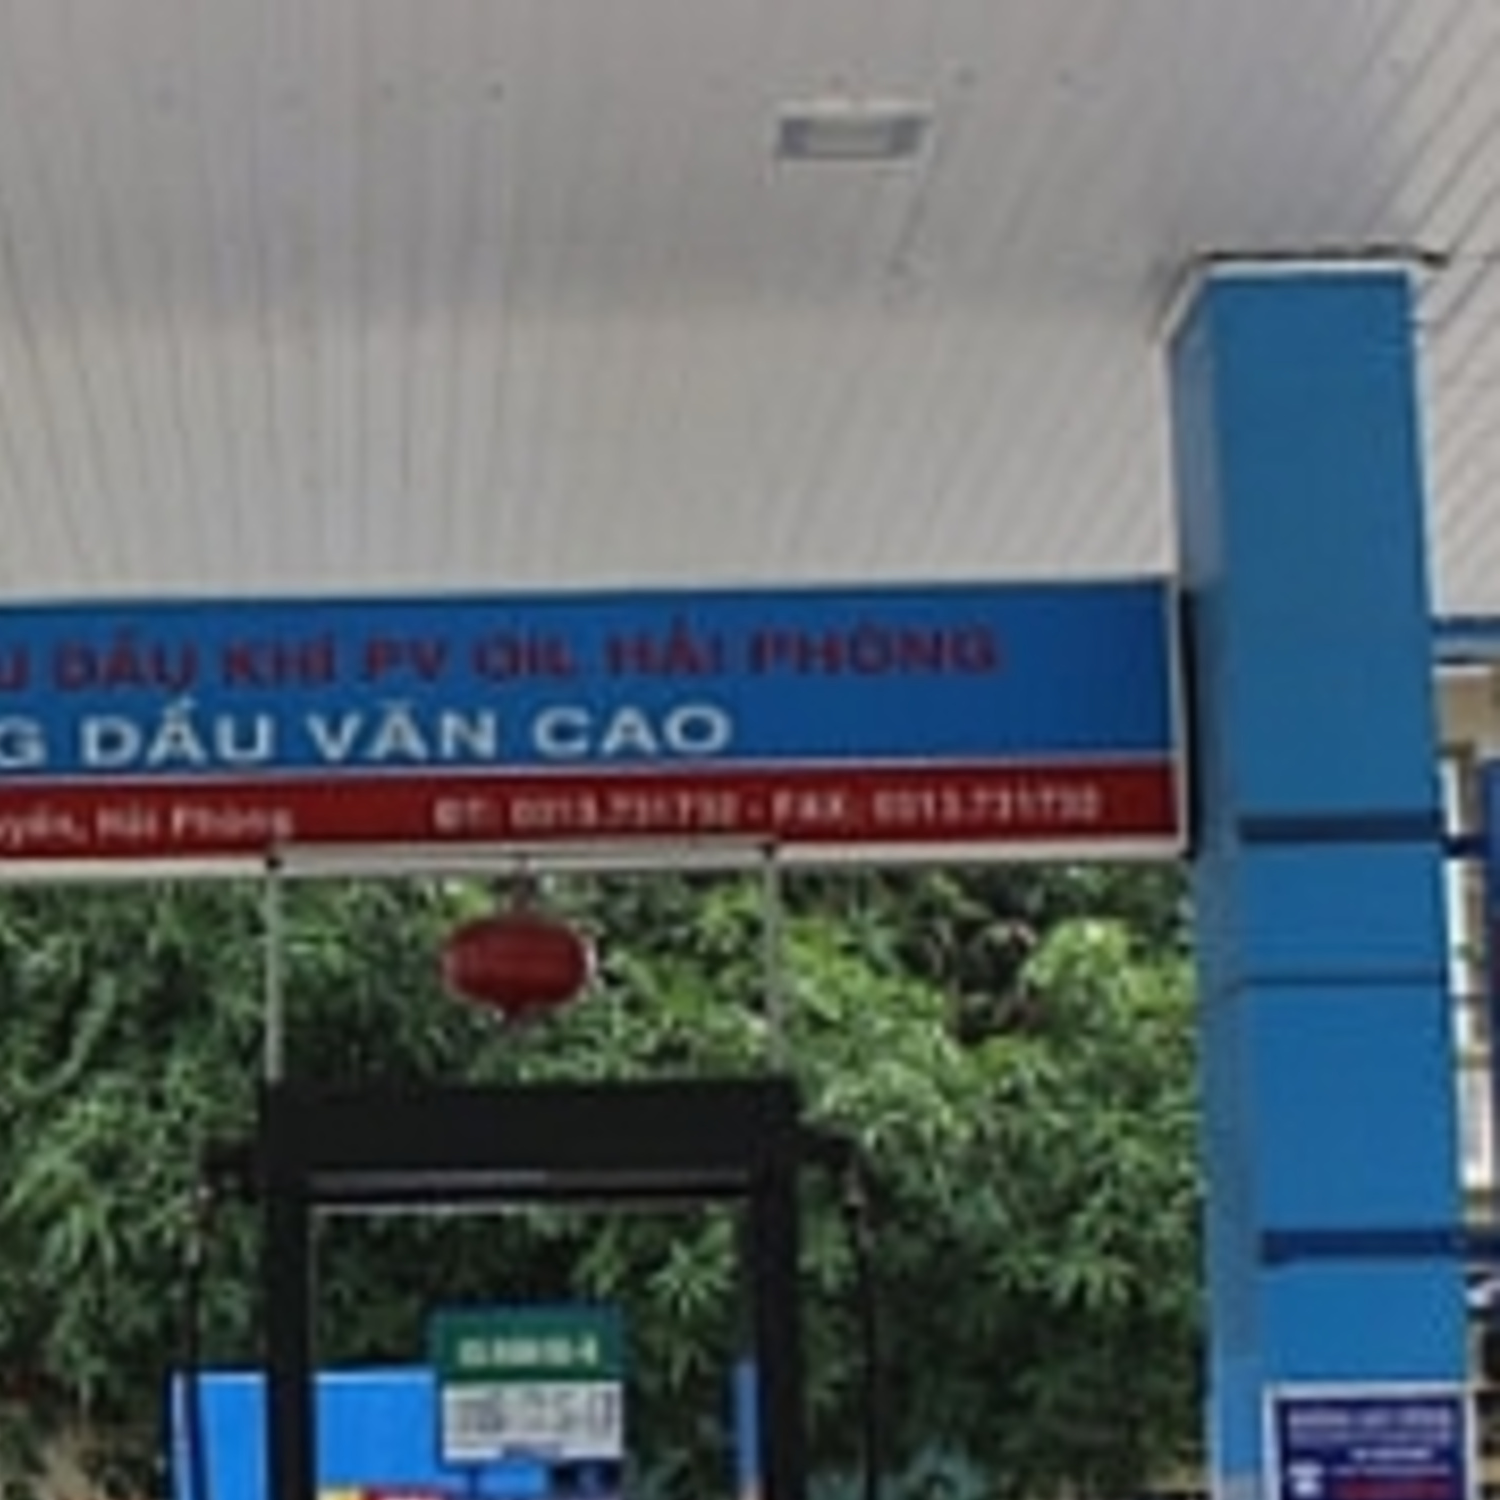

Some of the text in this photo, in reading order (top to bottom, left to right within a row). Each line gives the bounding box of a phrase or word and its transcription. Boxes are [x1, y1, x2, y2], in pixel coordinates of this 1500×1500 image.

[366, 630, 450, 683] PV
[473, 627, 575, 681] OIL
[306, 697, 499, 761] VĂN
[531, 703, 734, 757] CAO
